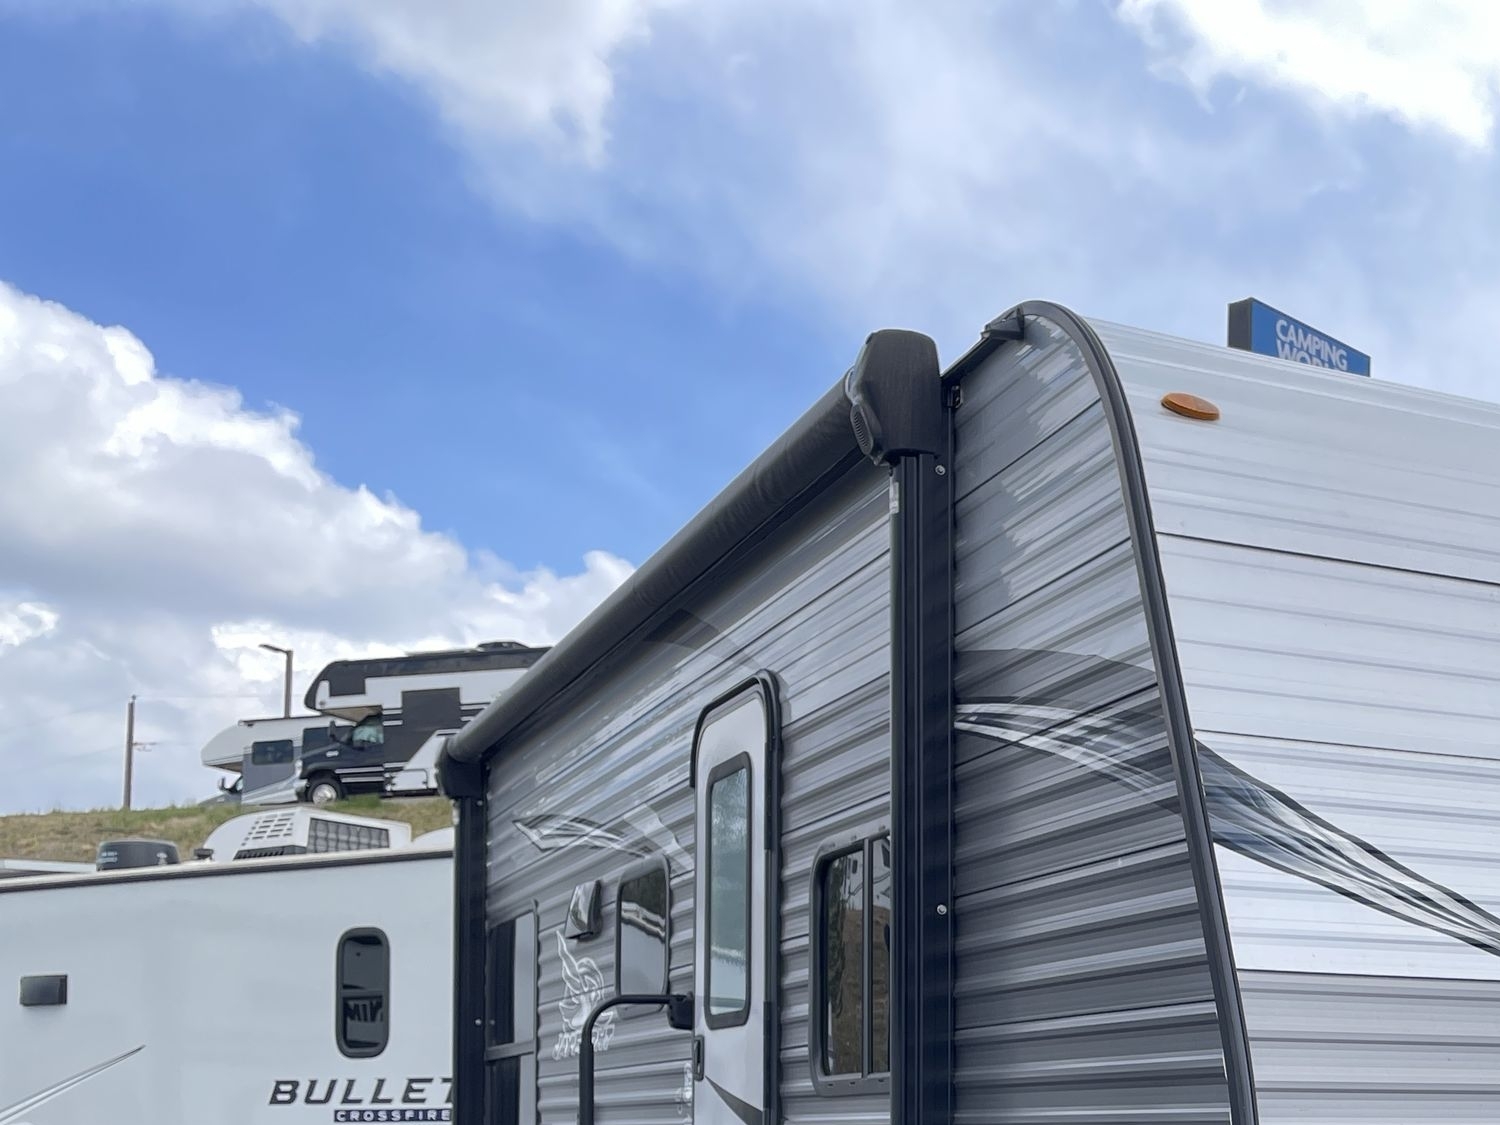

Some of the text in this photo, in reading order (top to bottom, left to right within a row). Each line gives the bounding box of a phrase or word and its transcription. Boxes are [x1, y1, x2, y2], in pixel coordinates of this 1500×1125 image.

[1275, 319, 1348, 371] CAMPING
[1275, 338, 1337, 369] WOR
[336, 1110, 450, 1121] CROSSFIRE
